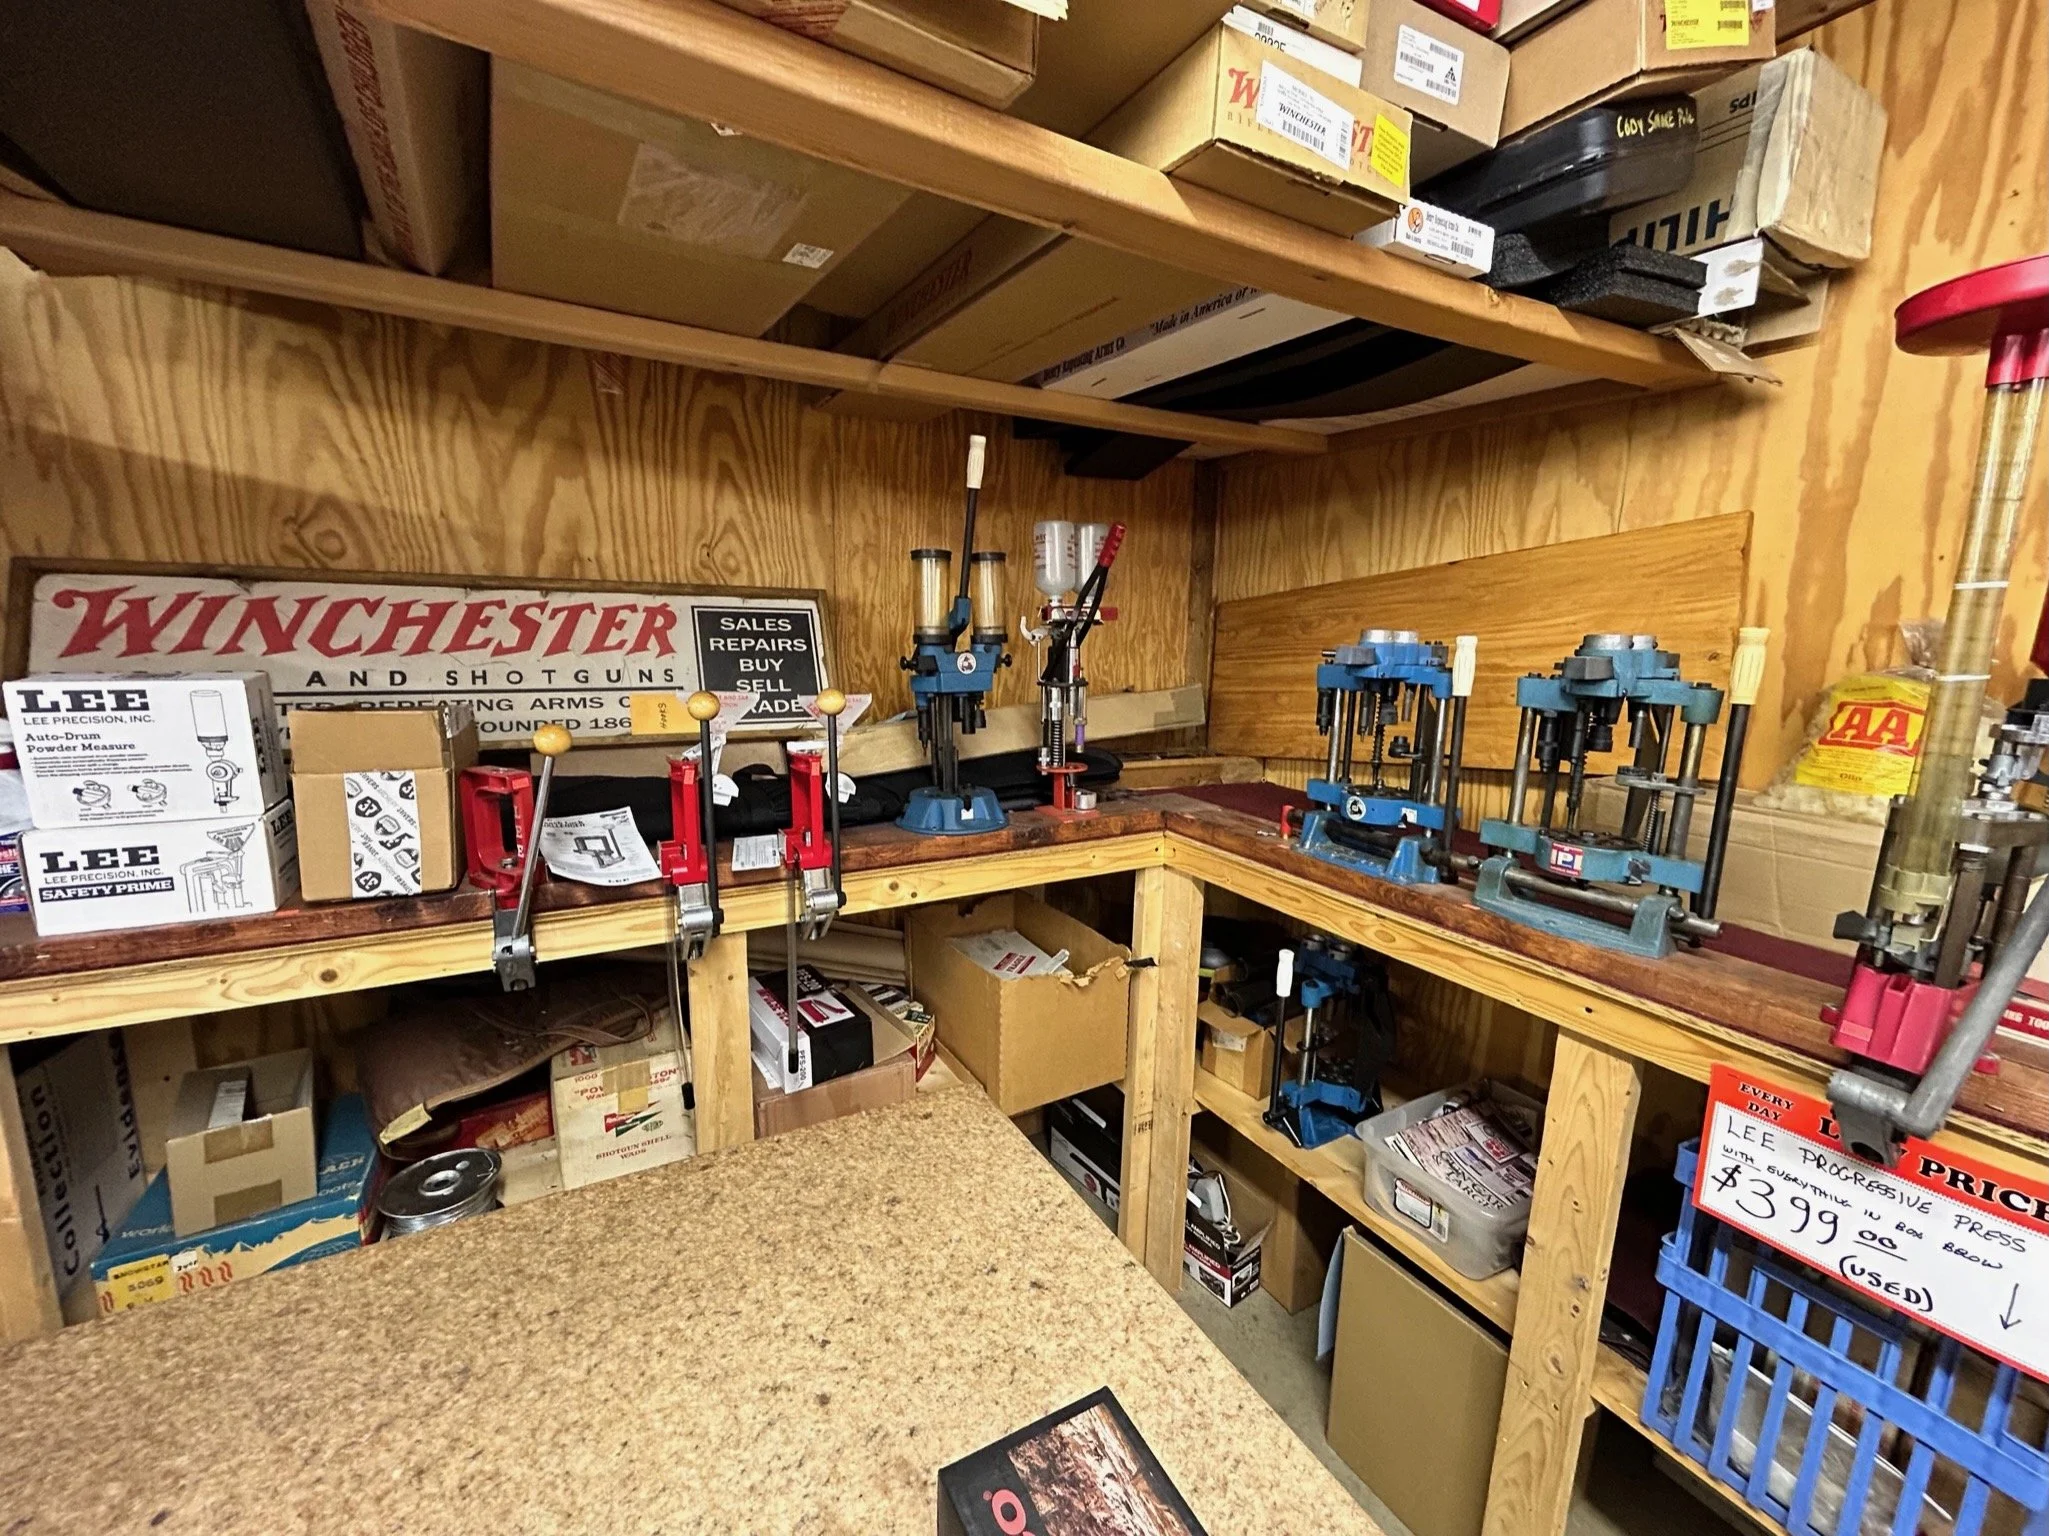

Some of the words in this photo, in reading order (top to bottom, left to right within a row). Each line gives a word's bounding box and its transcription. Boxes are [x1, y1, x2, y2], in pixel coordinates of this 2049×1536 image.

[1278, 101, 1327, 136] WINCHESTER
[1616, 115, 1645, 138] CODY
[1179, 308, 1190, 324] in
[1190, 294, 1232, 320] America
[52, 585, 677, 659] WINCHESTER
[720, 617, 792, 632] SALES
[709, 638, 808, 652] REPAIRS
[739, 658, 784, 672] BUY
[306, 669, 408, 687] AND
[446, 668, 674, 687] SHOTGUNS
[735, 679, 792, 693] SELL
[16, 689, 150, 713] LEE
[529, 696, 605, 711] ARMS
[23, 717, 49, 726] LEE
[53, 715, 128, 725] PRECISION,
[129, 714, 156, 724] INC.
[1829, 707, 1910, 748] AA
[24, 732, 102, 743] Auto-Drum
[26, 743, 78, 754] Powder
[81, 741, 136, 752] Measure
[39, 845, 160, 874] LEE
[44, 875, 68, 885] LEE
[140, 868, 165, 877] INC.
[41, 884, 112, 901] SAFETY
[115, 879, 173, 894] PRIME
[799, 1049, 808, 1082] PFS-200
[1740, 1082, 1794, 1112] EVERY
[1747, 1101, 1783, 1121] DAY
[595, 1142, 640, 1160] SHOTGUN
[640, 1134, 672, 1149] SHELL
[620, 1148, 647, 1160] WADS
[32, 1085, 80, 1277] Collection
[1727, 1115, 1776, 1152] LEE
[1799, 1146, 1933, 1215] PROGRESSIVE
[1954, 1213, 2027, 1254] PRESS
[1722, 1143, 1755, 1165] WITH
[1766, 1164, 1853, 1209] EVERYTHING
[1863, 1208, 1881, 1221] IN
[1895, 1221, 1923, 1240] BOX
[1942, 1241, 2003, 1270] BELOW
[1190, 1222, 1221, 1250] AMPLIFIED
[1839, 1254, 1935, 1313] (USED)
